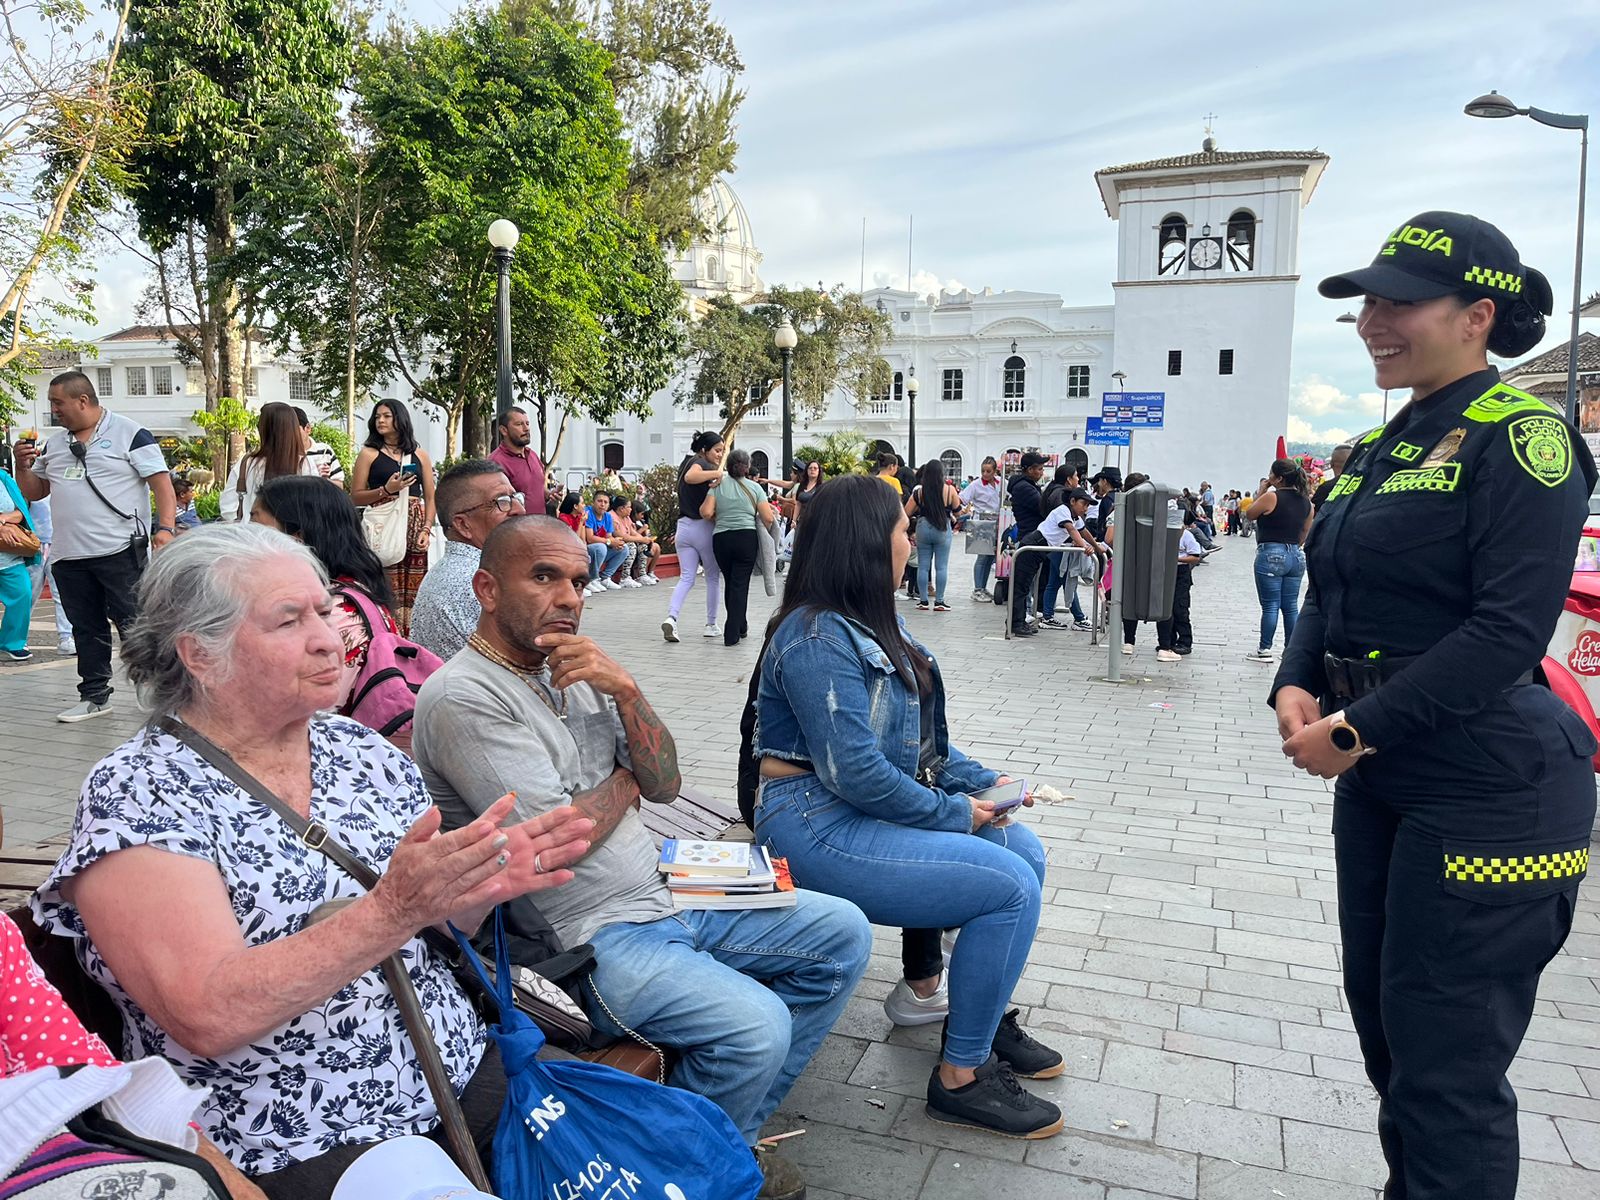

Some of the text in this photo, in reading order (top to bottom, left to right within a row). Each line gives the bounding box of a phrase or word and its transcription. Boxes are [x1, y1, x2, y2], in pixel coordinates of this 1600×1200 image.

[1386, 225, 1453, 256] LICÍA
[1087, 429, 1129, 438] SuperGIROS
[1515, 427, 1567, 447] NACIONAL
[1579, 635, 1600, 652] Cre
[1571, 650, 1600, 672] Hela
